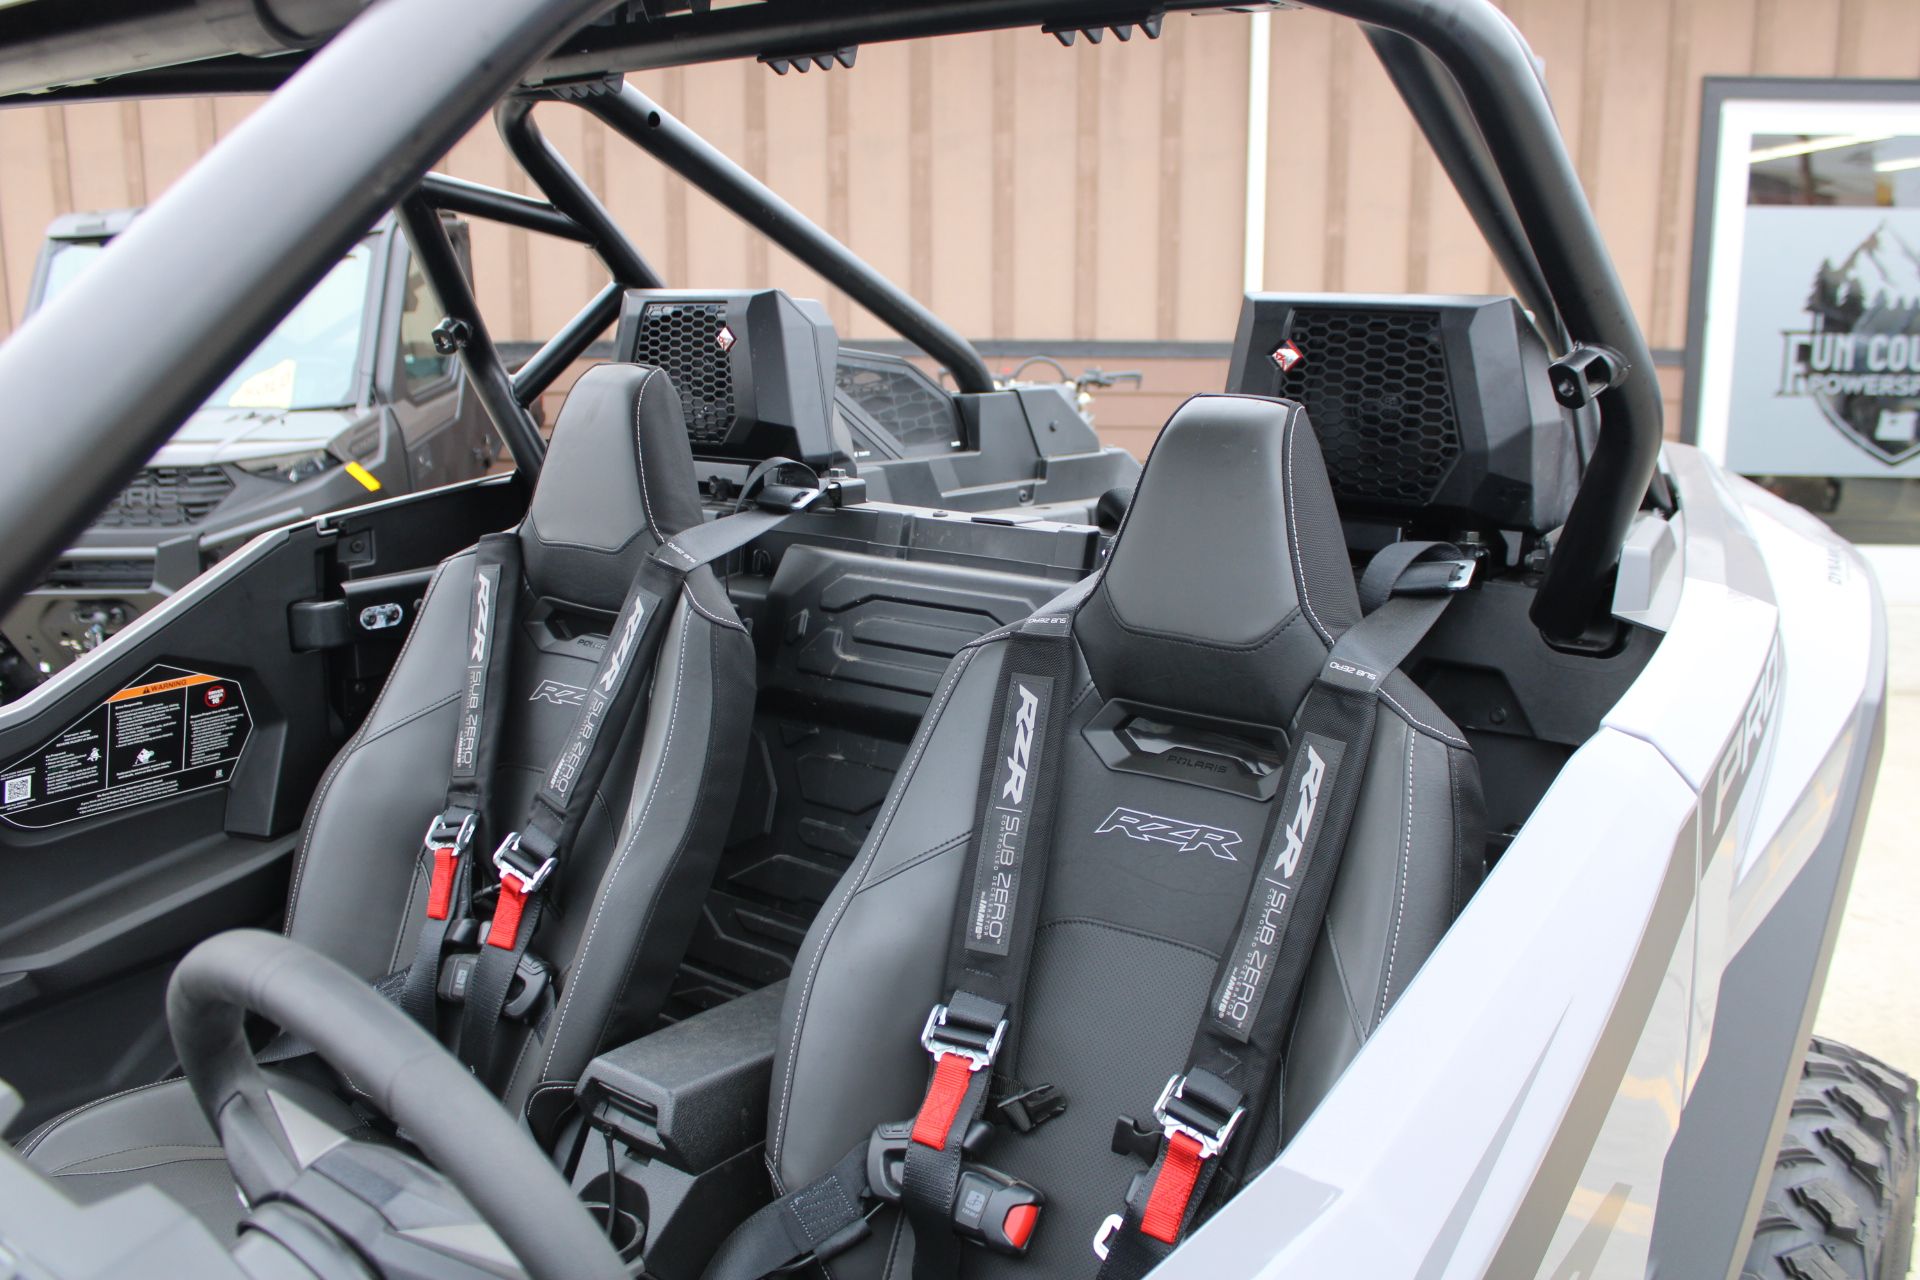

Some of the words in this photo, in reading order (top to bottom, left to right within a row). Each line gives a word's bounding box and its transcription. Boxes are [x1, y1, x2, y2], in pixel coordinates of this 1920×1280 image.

[471, 573, 490, 663] RZR
[600, 595, 644, 692] RZR
[150, 679, 187, 692] WARNING
[469, 671, 481, 709] SUB
[1329, 661, 1356, 674] ZERO
[1356, 669, 1377, 680] SUB
[464, 714, 478, 764] ZERO
[583, 701, 604, 739] SUB
[1002, 684, 1038, 805] RZR
[557, 741, 586, 793] ZERO
[1166, 754, 1228, 773] POLARIS
[1095, 807, 1243, 861] RZR
[1273, 744, 1326, 880] RZR
[999, 816, 1020, 866] SUB
[988, 872, 1012, 938] ZERO
[1259, 892, 1287, 946] SUB
[1231, 950, 1268, 1021] ZERO
